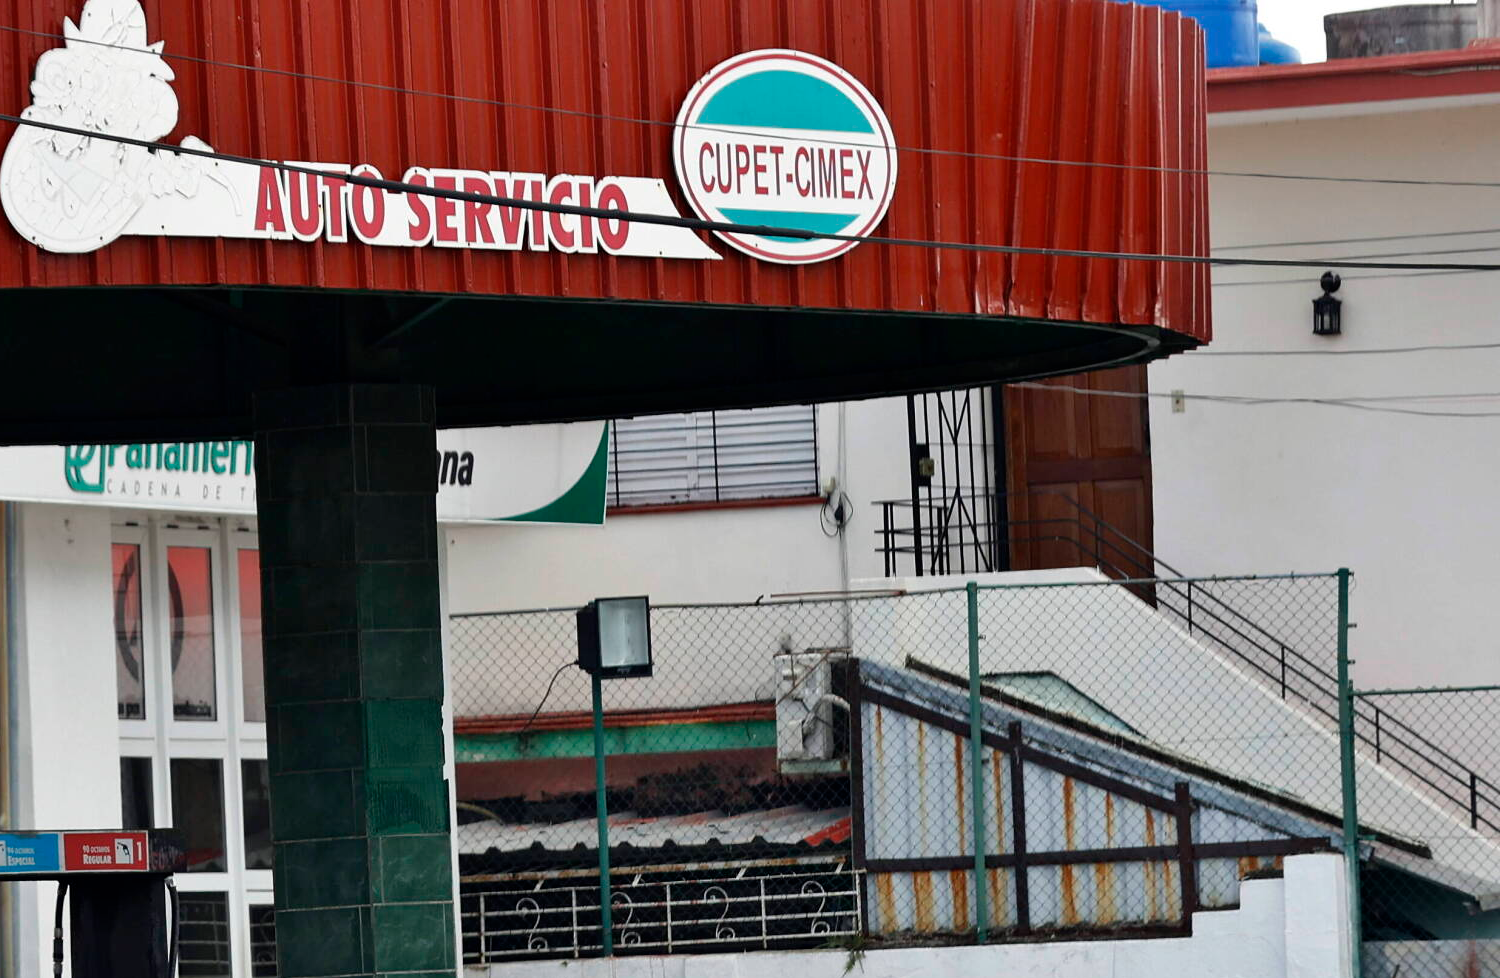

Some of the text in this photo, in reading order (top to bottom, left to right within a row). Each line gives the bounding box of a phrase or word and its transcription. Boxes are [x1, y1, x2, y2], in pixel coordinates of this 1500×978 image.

[699, 141, 874, 200] CUPET-CIMEX
[253, 165, 630, 250] AUTO SERVICIO
[436, 450, 475, 486] na
[107, 479, 181, 497] CADENA
[202, 485, 222, 500] DE
[8, 855, 36, 867] ESPECIAL
[82, 854, 112, 865] REGULAR
[136, 841, 143, 861] 1
